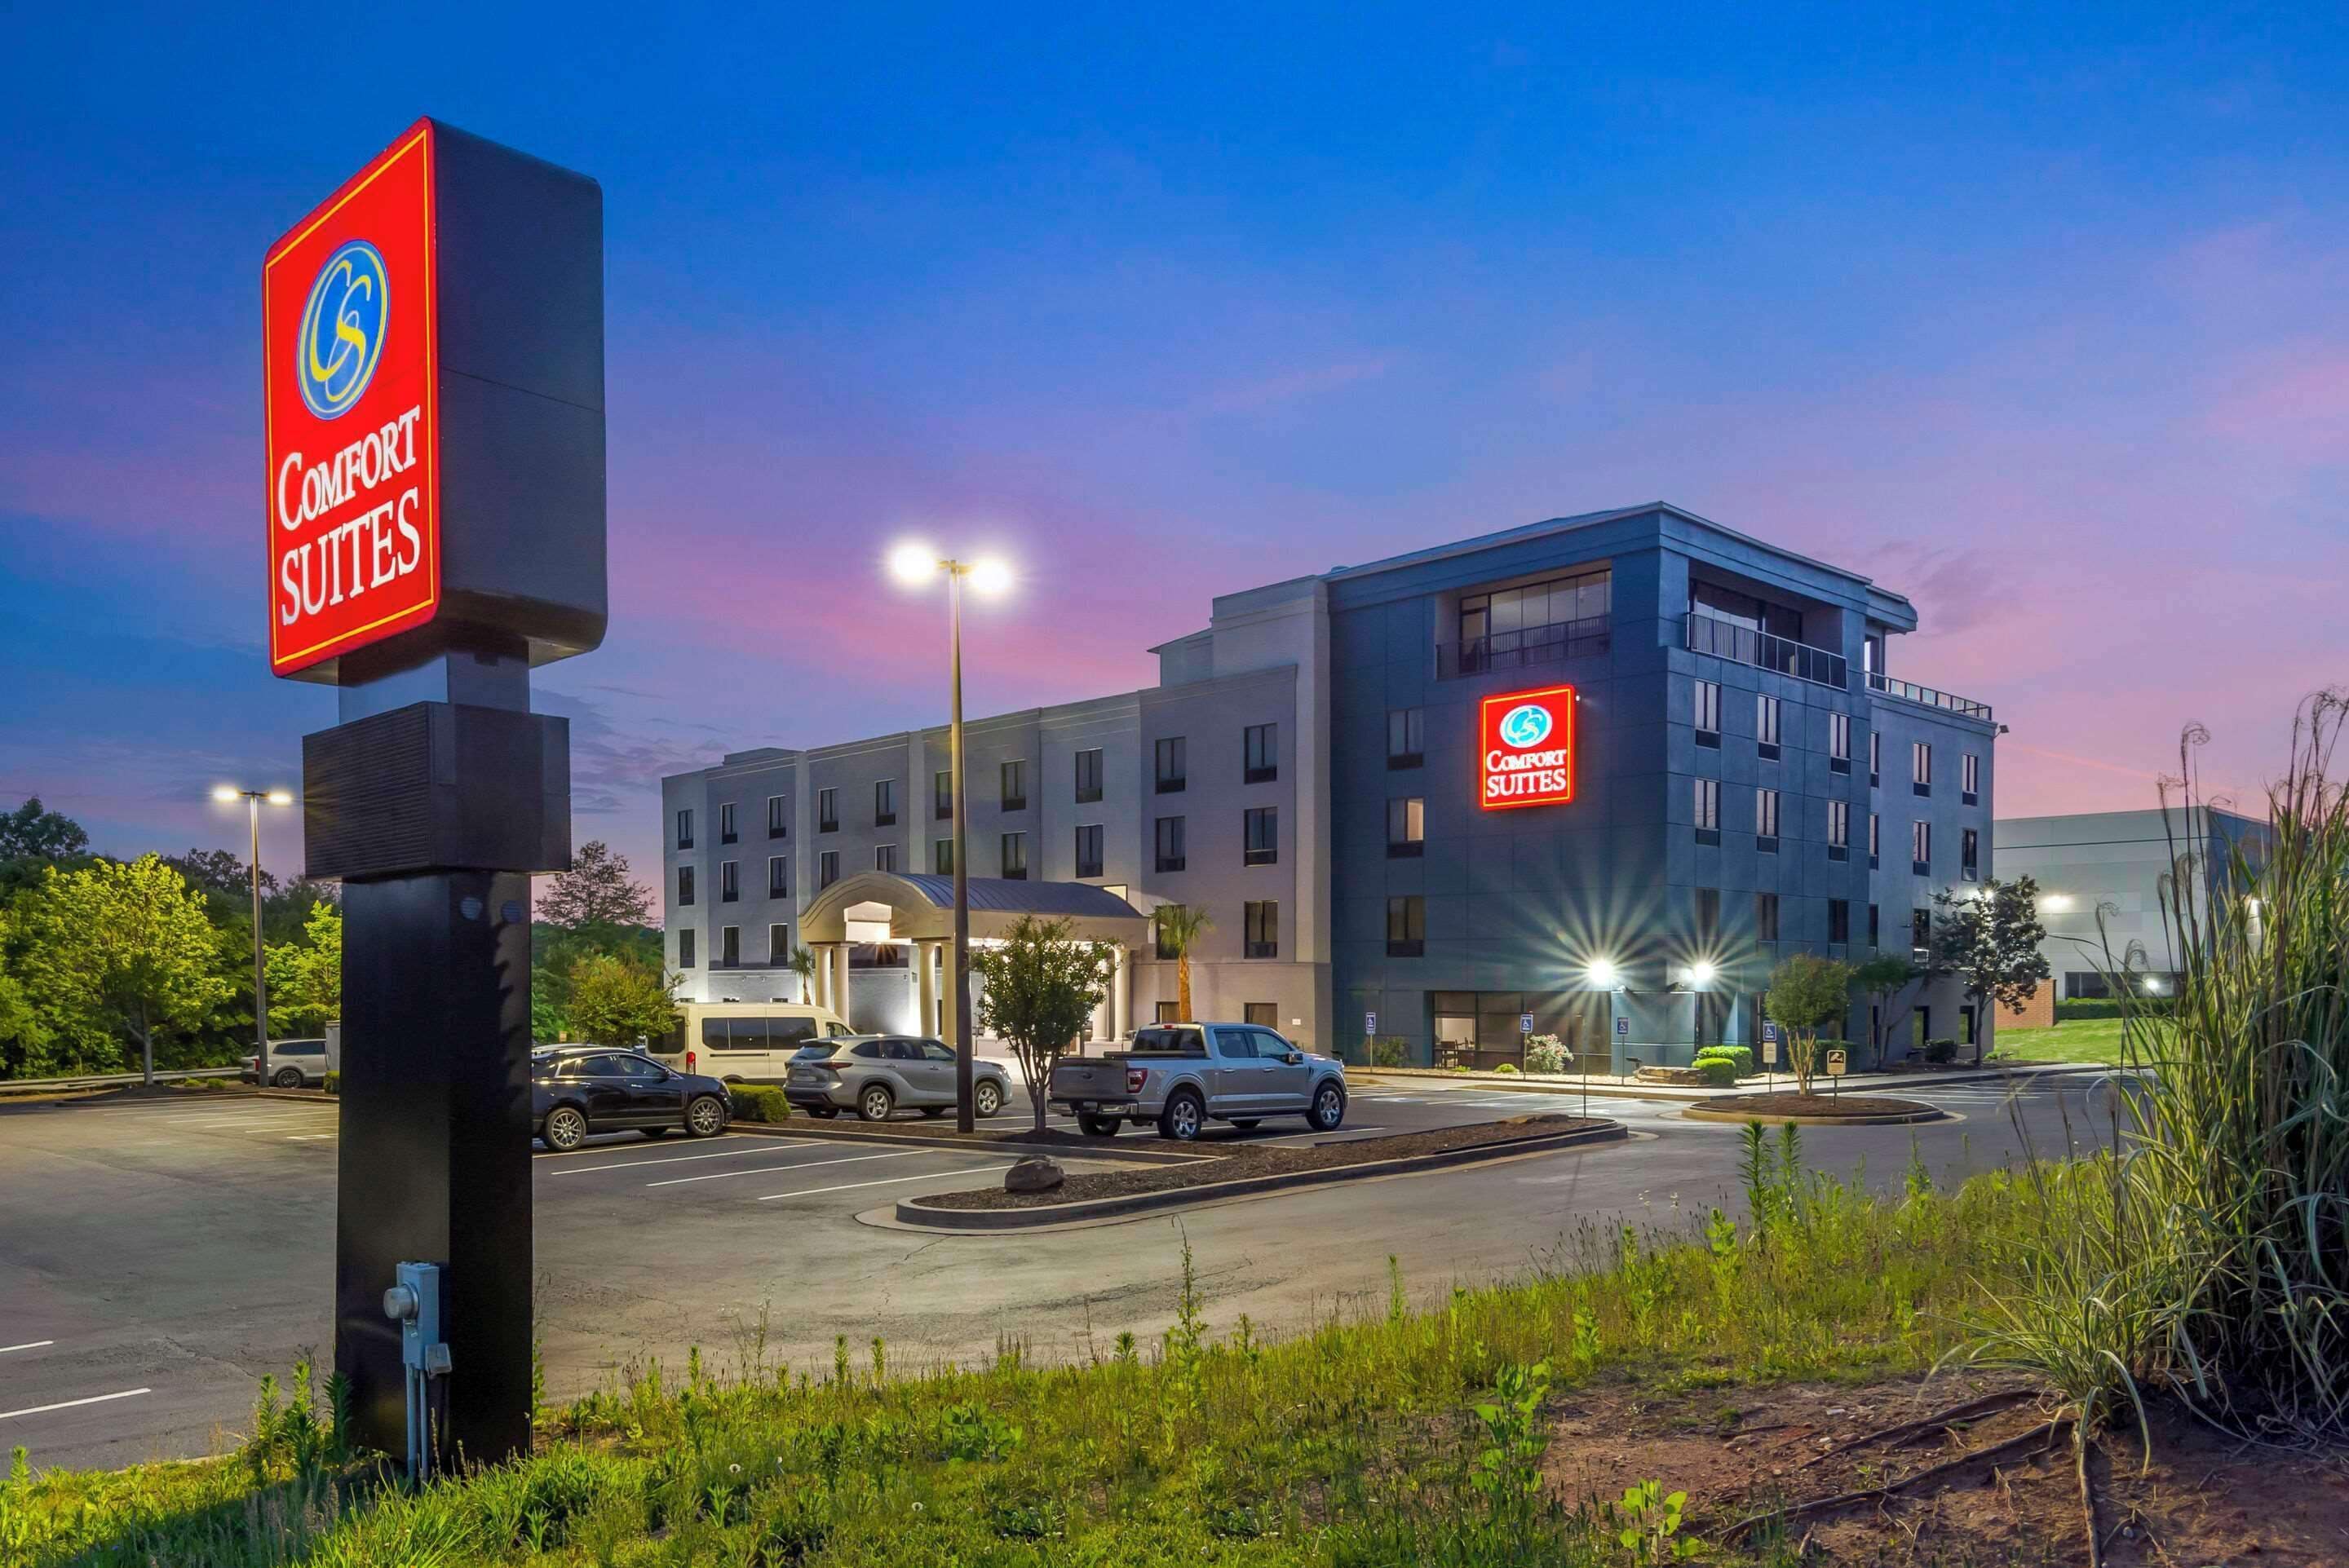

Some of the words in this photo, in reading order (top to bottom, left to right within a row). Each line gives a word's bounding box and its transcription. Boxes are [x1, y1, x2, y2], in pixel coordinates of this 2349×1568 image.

[278, 404, 421, 532] COMFORT
[281, 487, 421, 626] SUITES
[1486, 749, 1567, 773] COMFORT
[1487, 768, 1567, 797] SUITES
